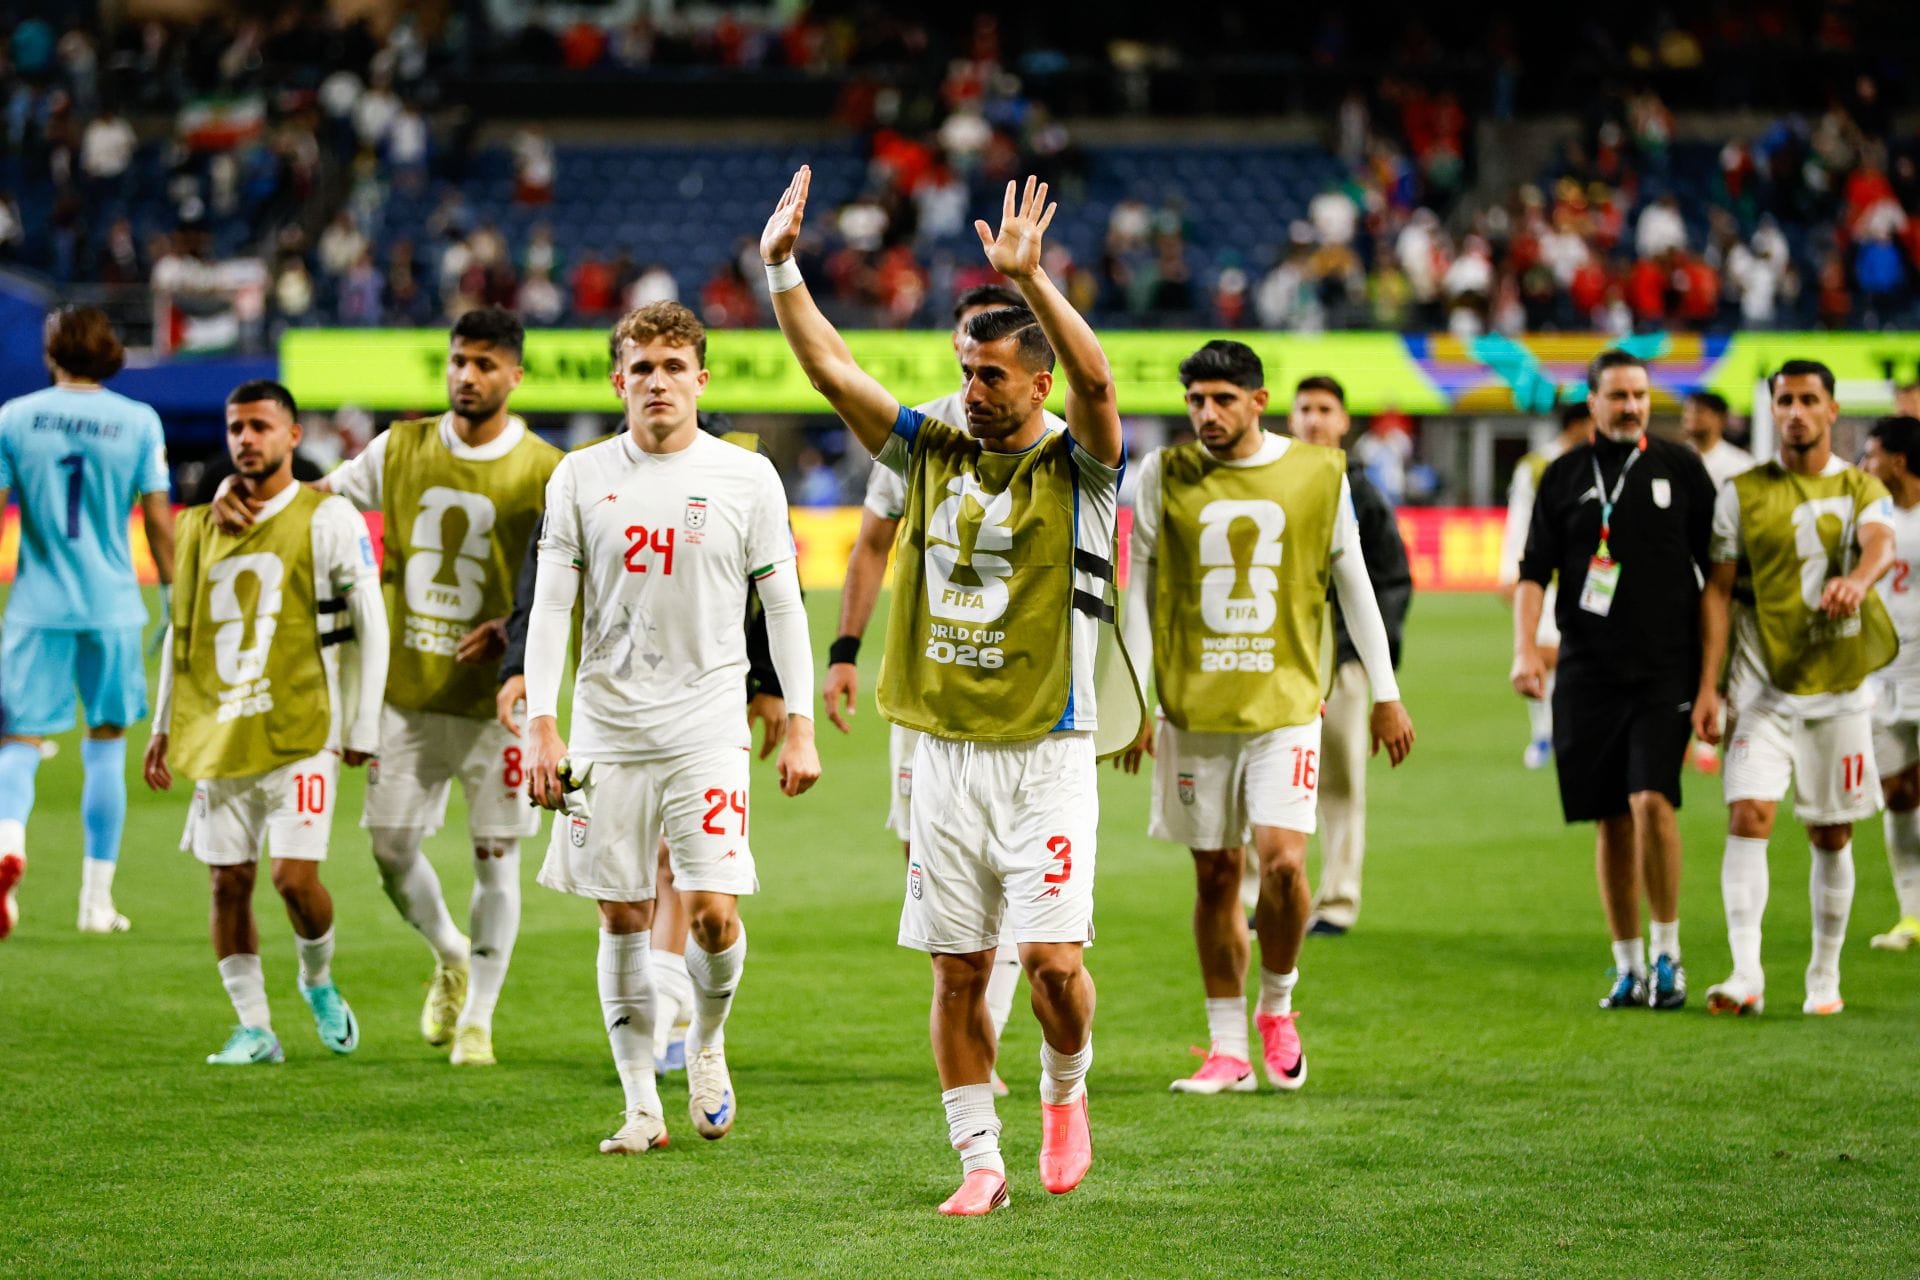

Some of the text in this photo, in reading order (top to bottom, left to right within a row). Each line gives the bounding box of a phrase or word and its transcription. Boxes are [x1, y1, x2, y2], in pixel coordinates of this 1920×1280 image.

[56, 452, 84, 538] 1
[624, 525, 675, 576] 24
[425, 589, 461, 607] FIFA
[941, 588, 985, 609] FIFA
[1225, 606, 1259, 621] FIFA
[403, 629, 457, 657] 202
[972, 629, 1006, 644] CUP
[1202, 636, 1250, 651] WORLD
[1201, 651, 1275, 673] 2026
[503, 746, 523, 789] 8
[1291, 746, 1317, 791] 16
[1842, 753, 1864, 792] 11
[293, 774, 325, 814] 10
[702, 788, 746, 837] 24
[1044, 835, 1072, 884] 3
